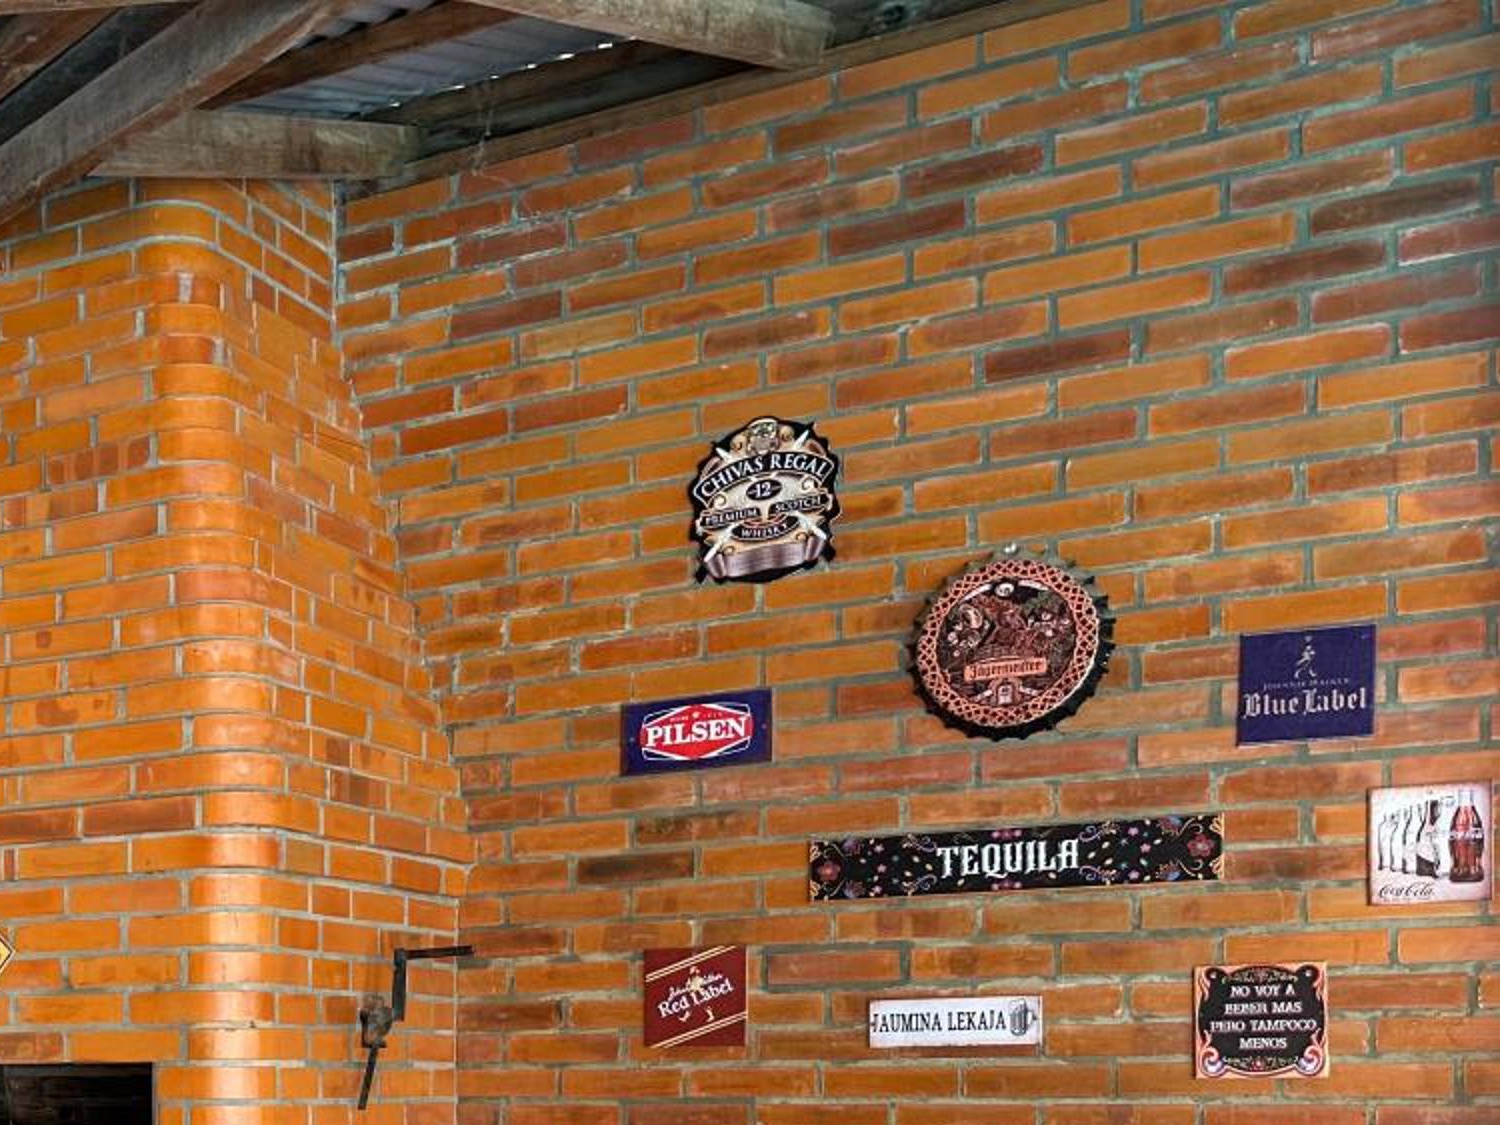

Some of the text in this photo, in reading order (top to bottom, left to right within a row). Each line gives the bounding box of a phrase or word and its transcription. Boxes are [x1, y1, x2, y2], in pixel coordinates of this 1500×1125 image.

[701, 453, 827, 497] CHIVAS REGAL
[754, 481, 771, 498] 12
[775, 496, 822, 512] SCOTCH
[705, 508, 758, 526] PREMIUM
[740, 523, 788, 539] WHISKY
[1242, 687, 1366, 719] Blue Label
[645, 717, 748, 747] PILSEN
[936, 838, 1079, 879] TEQUILA
[657, 998, 690, 1018] Red
[691, 978, 734, 1005] Label
[1231, 983, 1296, 998] NO VOY A
[1224, 1002, 1302, 1015] BEBER MAS
[947, 1010, 1007, 1031] LEKAJA
[1210, 1019, 1317, 1033] PERO TAMPOCO
[1239, 1037, 1287, 1049] MENOS
